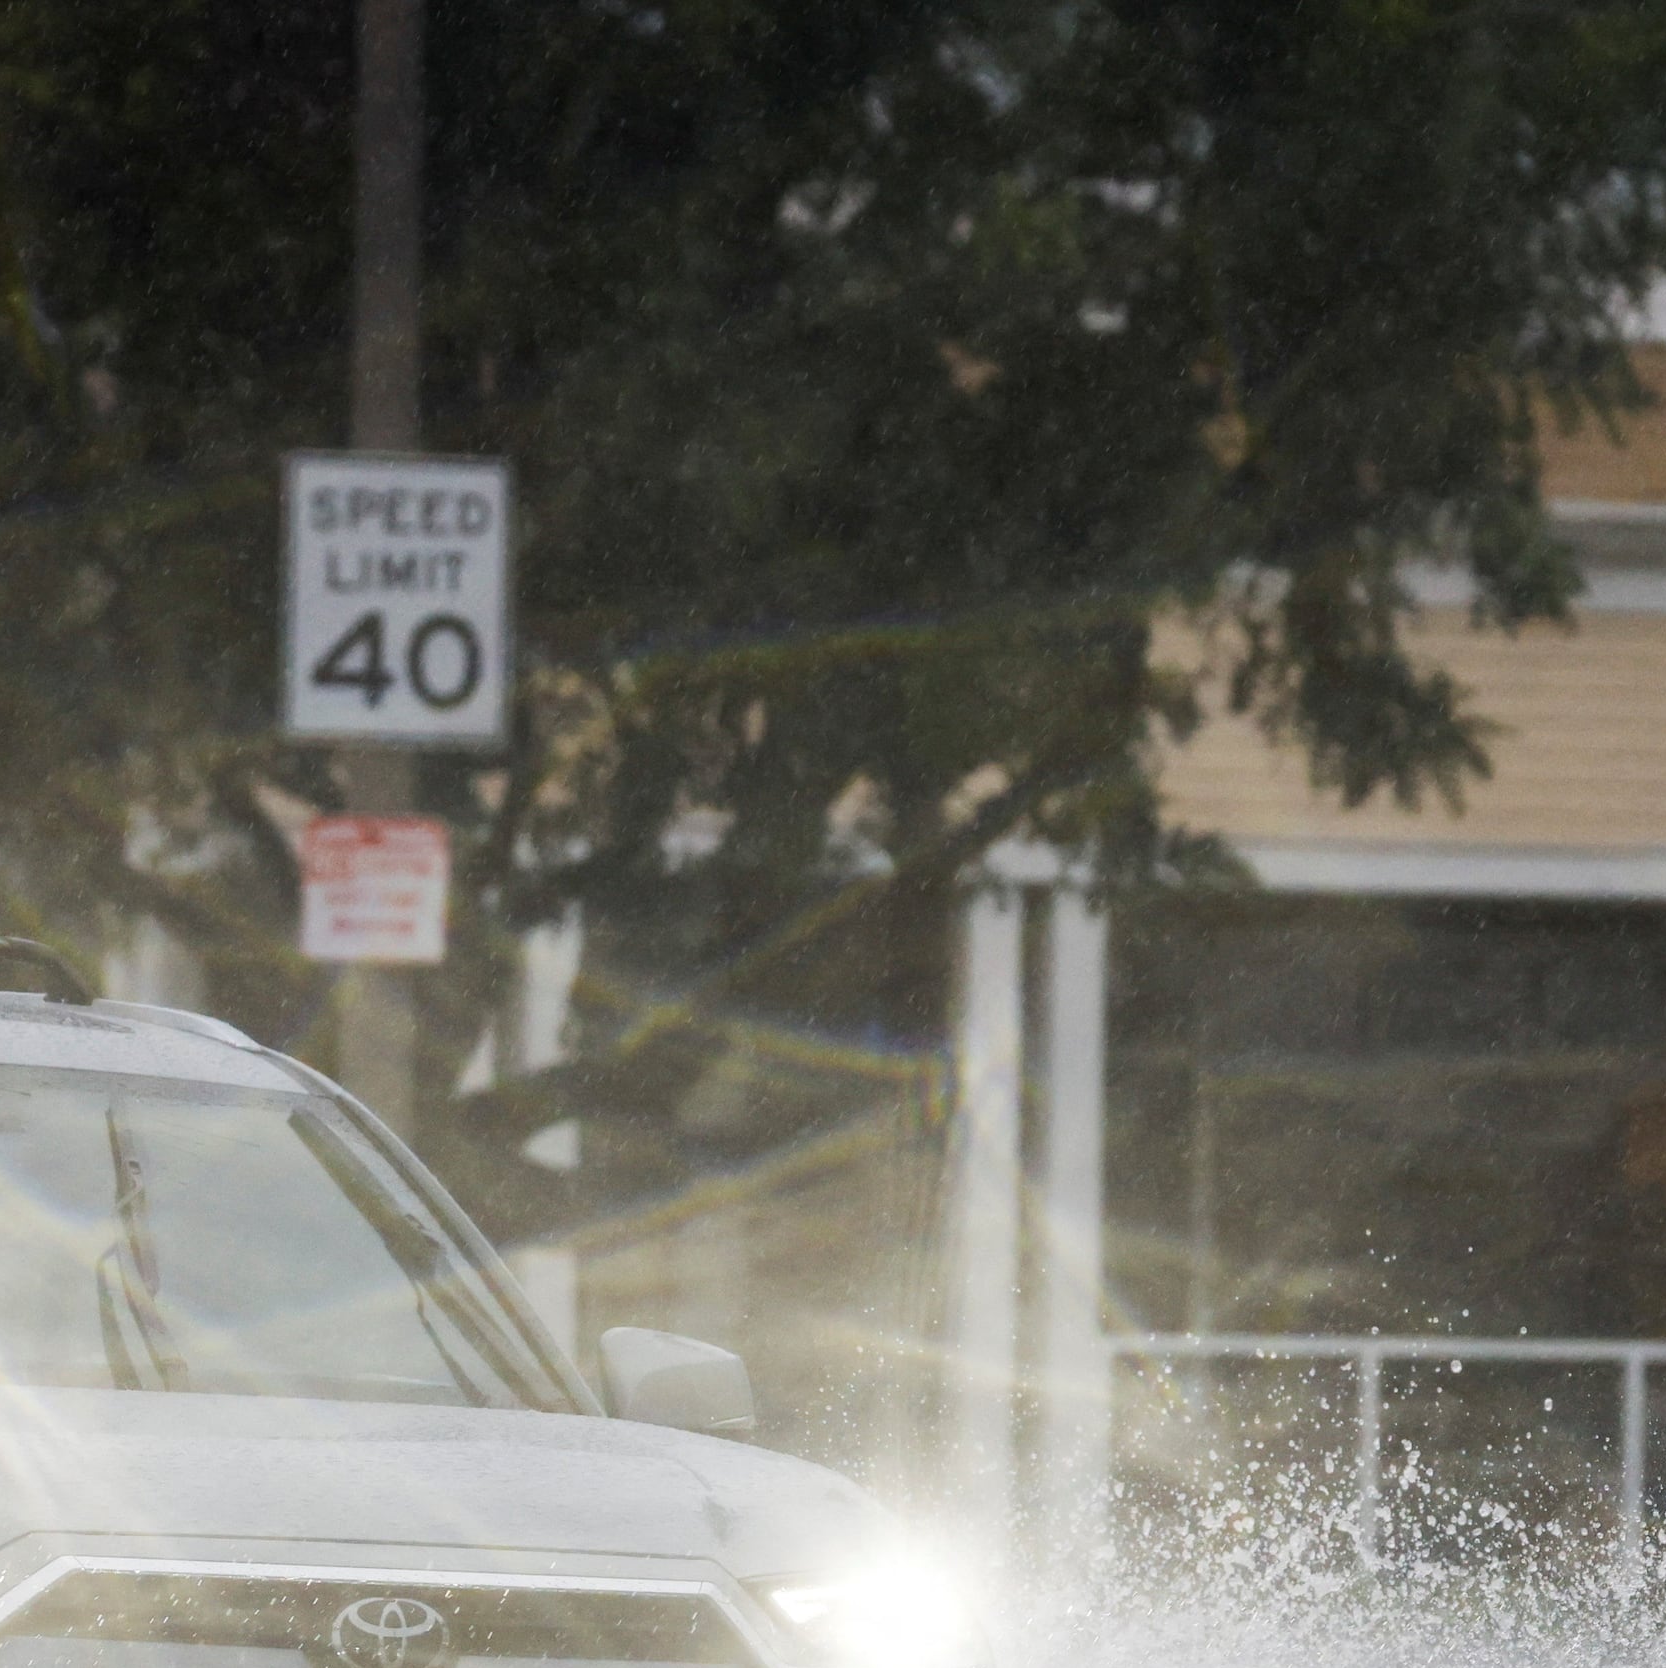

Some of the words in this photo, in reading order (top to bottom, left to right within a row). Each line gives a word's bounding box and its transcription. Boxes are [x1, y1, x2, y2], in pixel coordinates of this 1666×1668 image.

[309, 487, 491, 538] SPEED
[324, 550, 467, 593] LIMIT
[310, 607, 483, 712] 40
